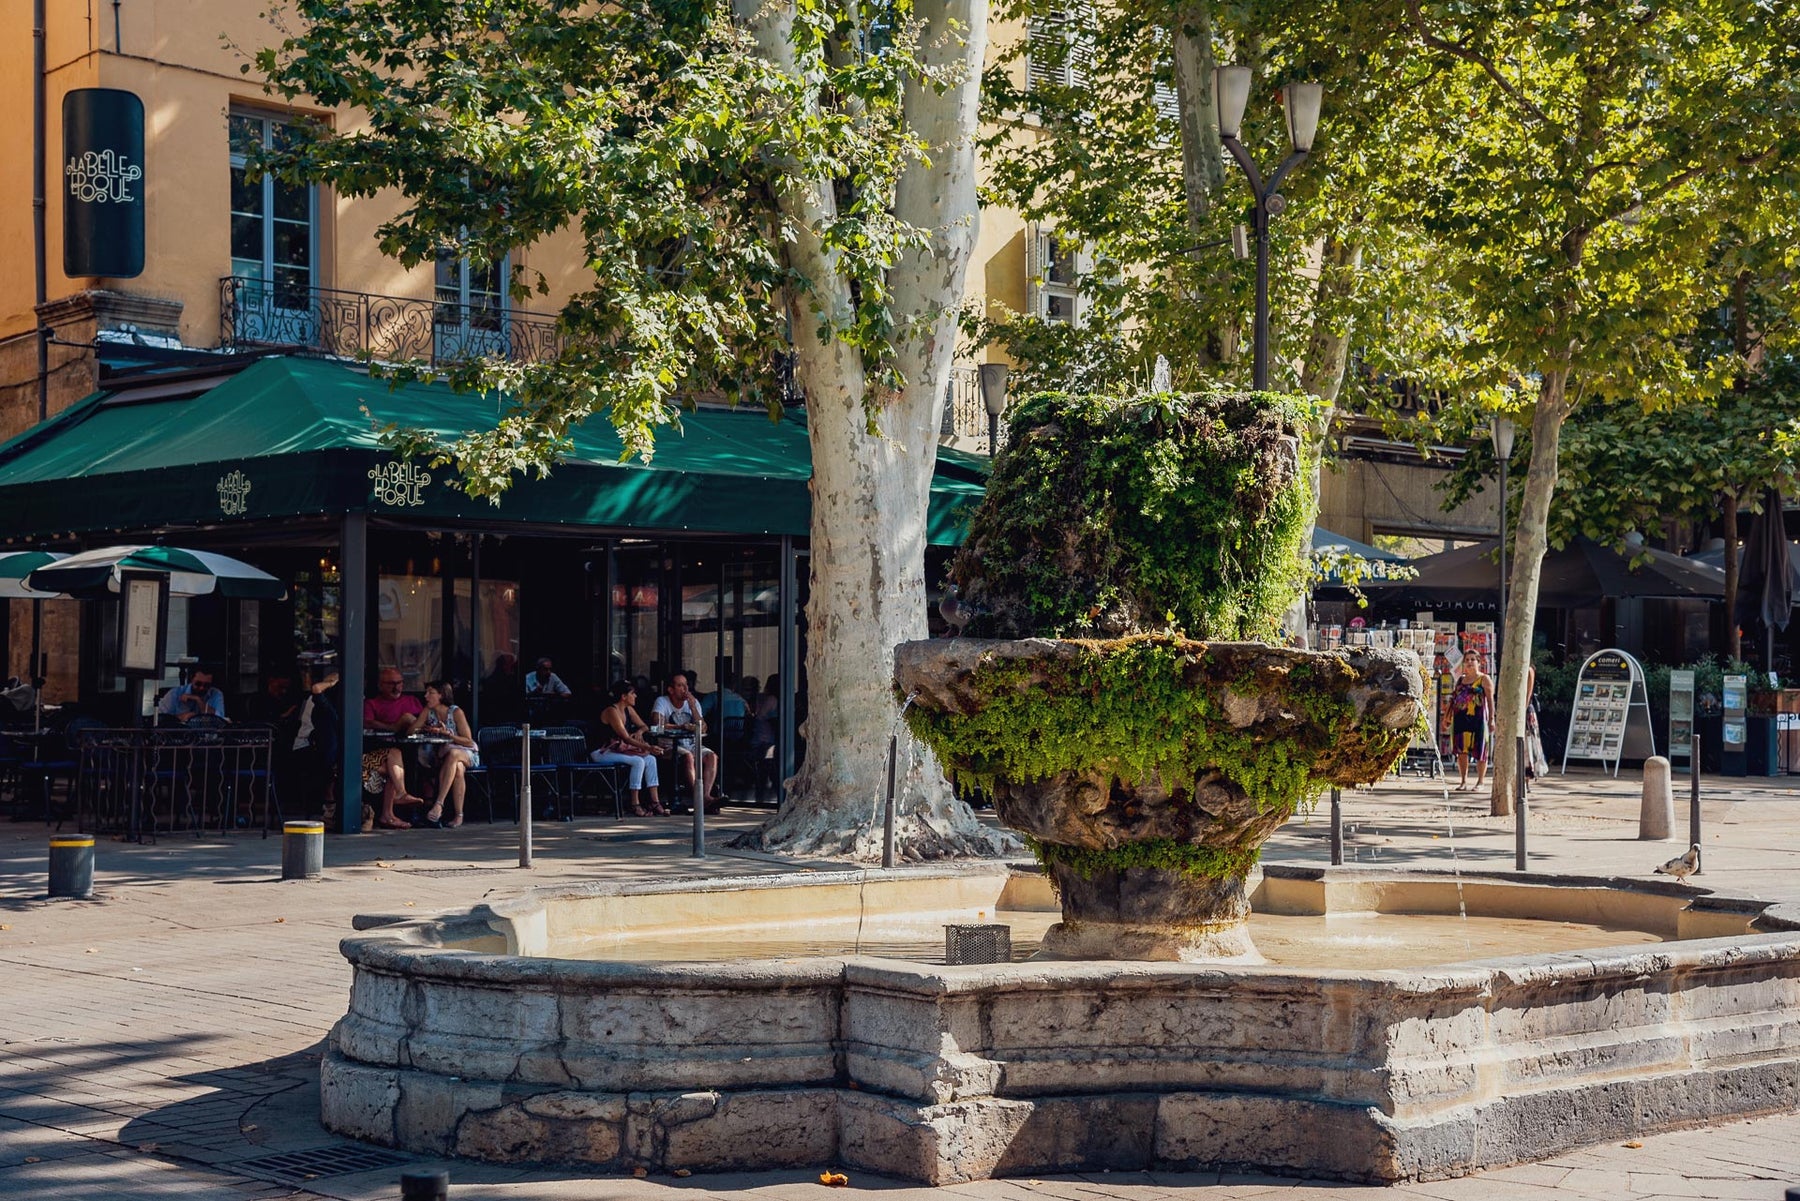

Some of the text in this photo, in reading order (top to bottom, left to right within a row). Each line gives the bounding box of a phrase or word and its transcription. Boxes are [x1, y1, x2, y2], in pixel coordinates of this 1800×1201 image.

[66, 149, 142, 180] LA BELLE
[71, 172, 134, 203] EPOQUE
[216, 470, 251, 495] LA BELLE
[368, 461, 431, 487] LA BELLE
[374, 477, 425, 507] EPOQUE
